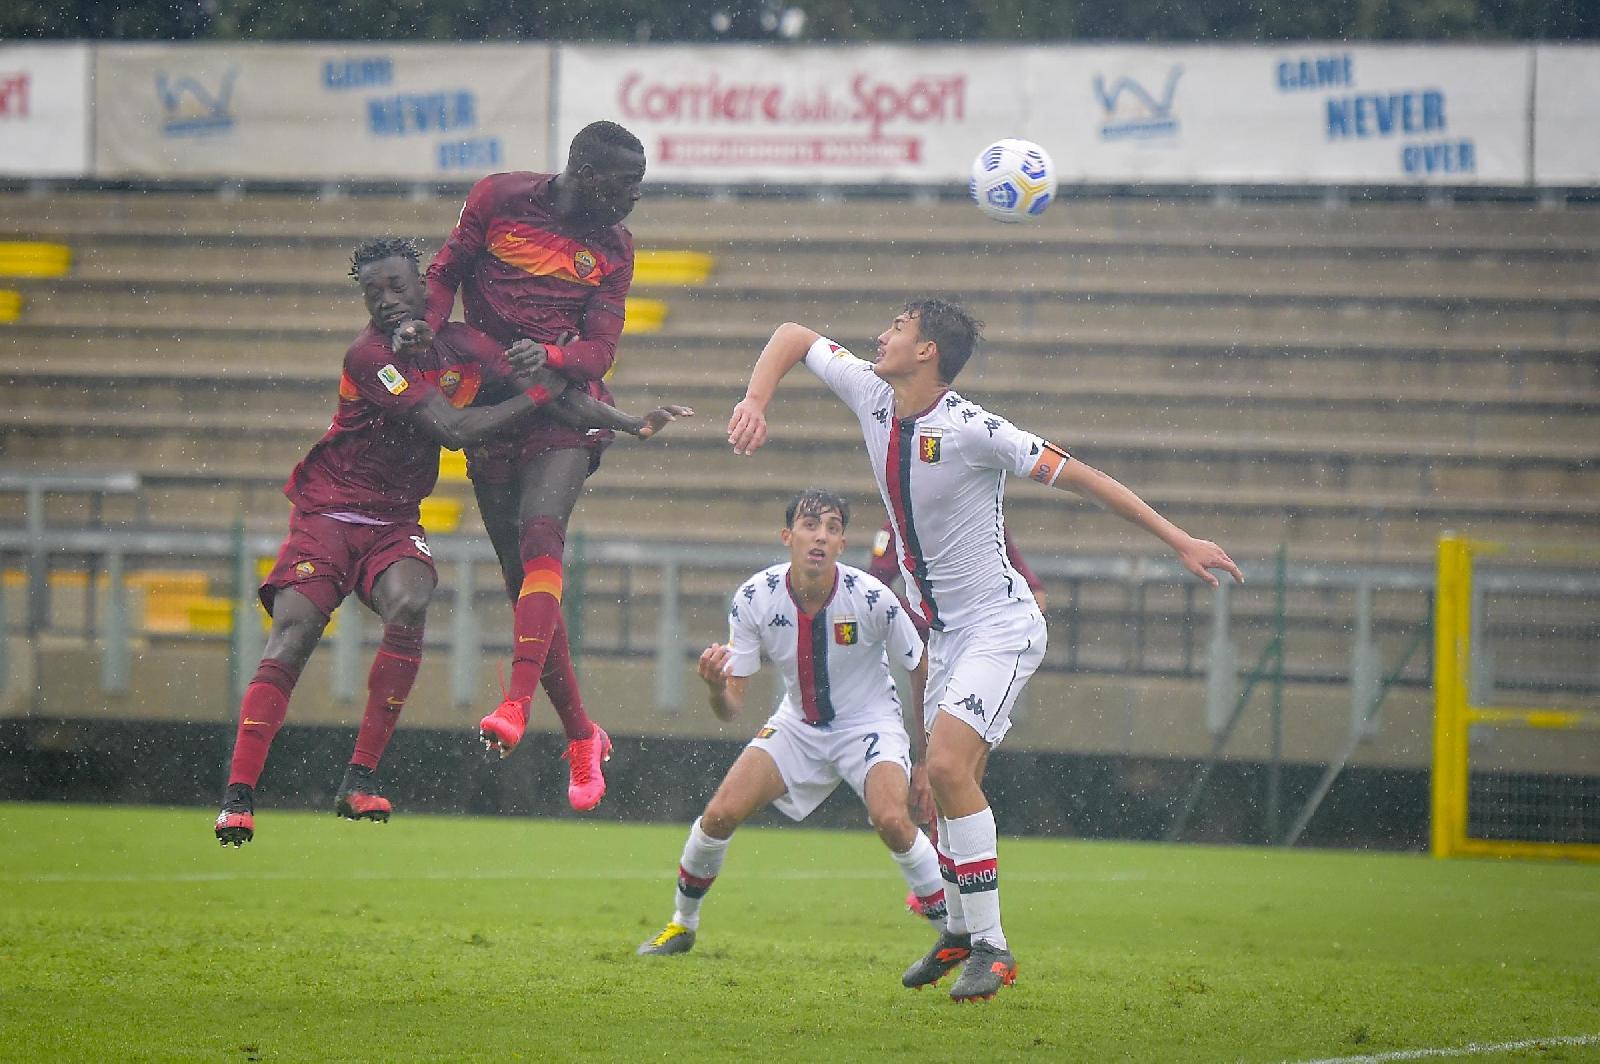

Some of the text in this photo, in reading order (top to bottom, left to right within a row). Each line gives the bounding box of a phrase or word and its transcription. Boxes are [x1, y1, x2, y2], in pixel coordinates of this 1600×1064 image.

[1278, 54, 1353, 90] GAME
[619, 72, 783, 121] Corriere
[850, 72, 967, 142] Sport
[1326, 90, 1445, 138] NEVER
[1402, 142, 1475, 174] OVER
[862, 732, 880, 762] 2
[957, 867, 997, 887] GENOA
